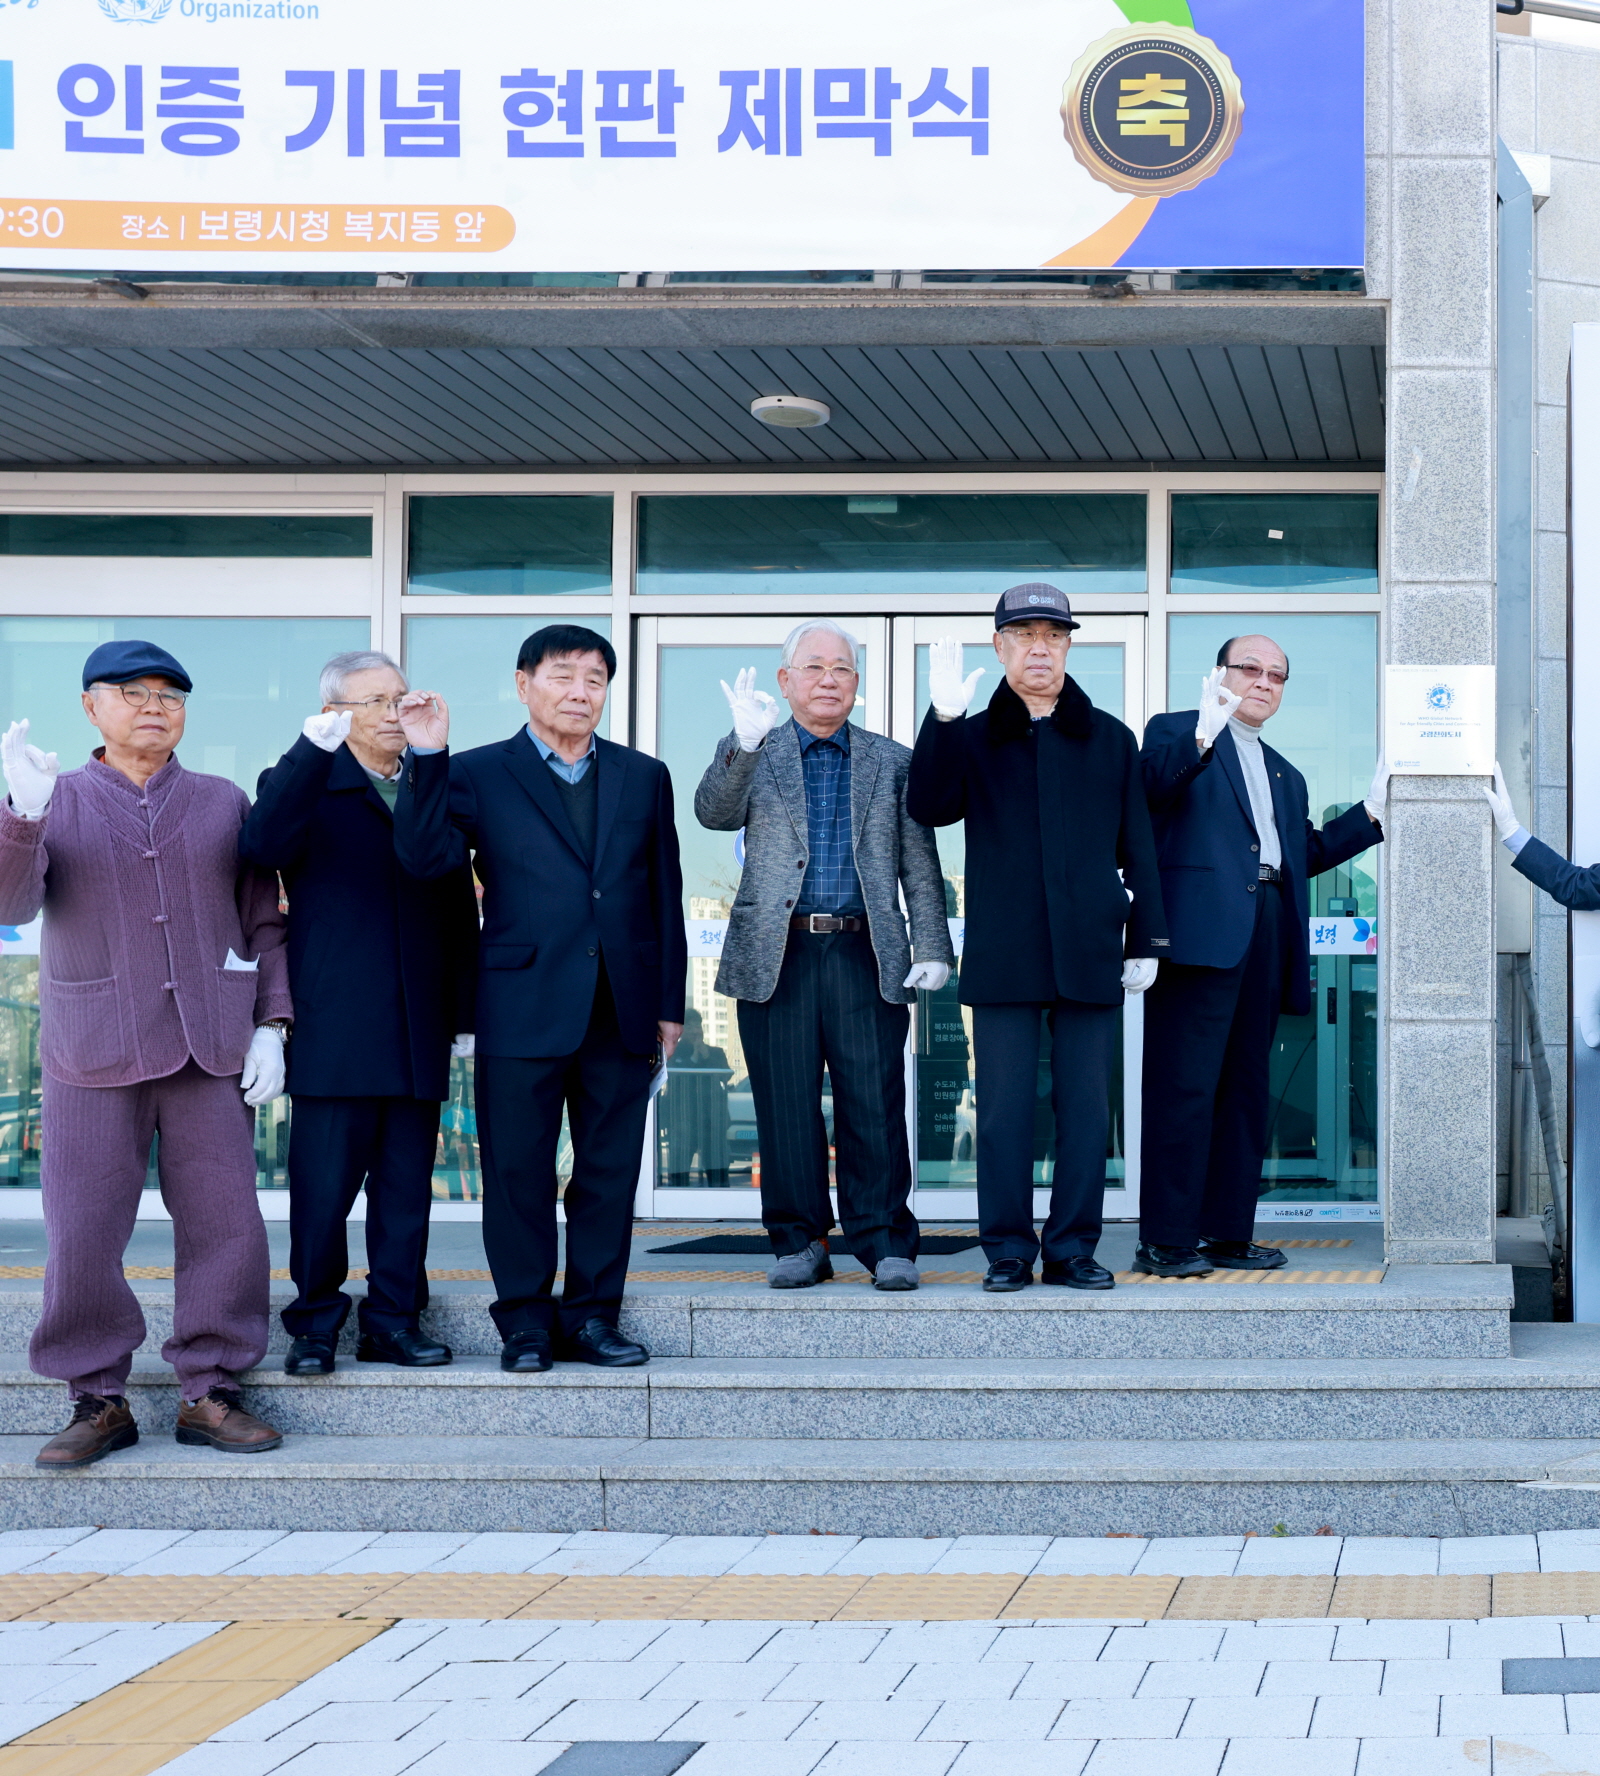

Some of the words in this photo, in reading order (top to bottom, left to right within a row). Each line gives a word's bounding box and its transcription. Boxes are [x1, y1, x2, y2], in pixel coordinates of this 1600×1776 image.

[180, 0, 319, 23] Organization
[57, 63, 244, 156] 인증
[285, 69, 461, 158] 기념
[501, 68, 684, 158] 현판
[717, 67, 989, 156] 제막식
[1116, 73, 1190, 147] 축
[0, 206, 65, 239] :30
[121, 214, 170, 240] 장소
[198, 211, 329, 243] 보령시청
[344, 212, 441, 243] 복지동
[454, 212, 486, 243] 앞
[1315, 924, 1337, 945] 보령
